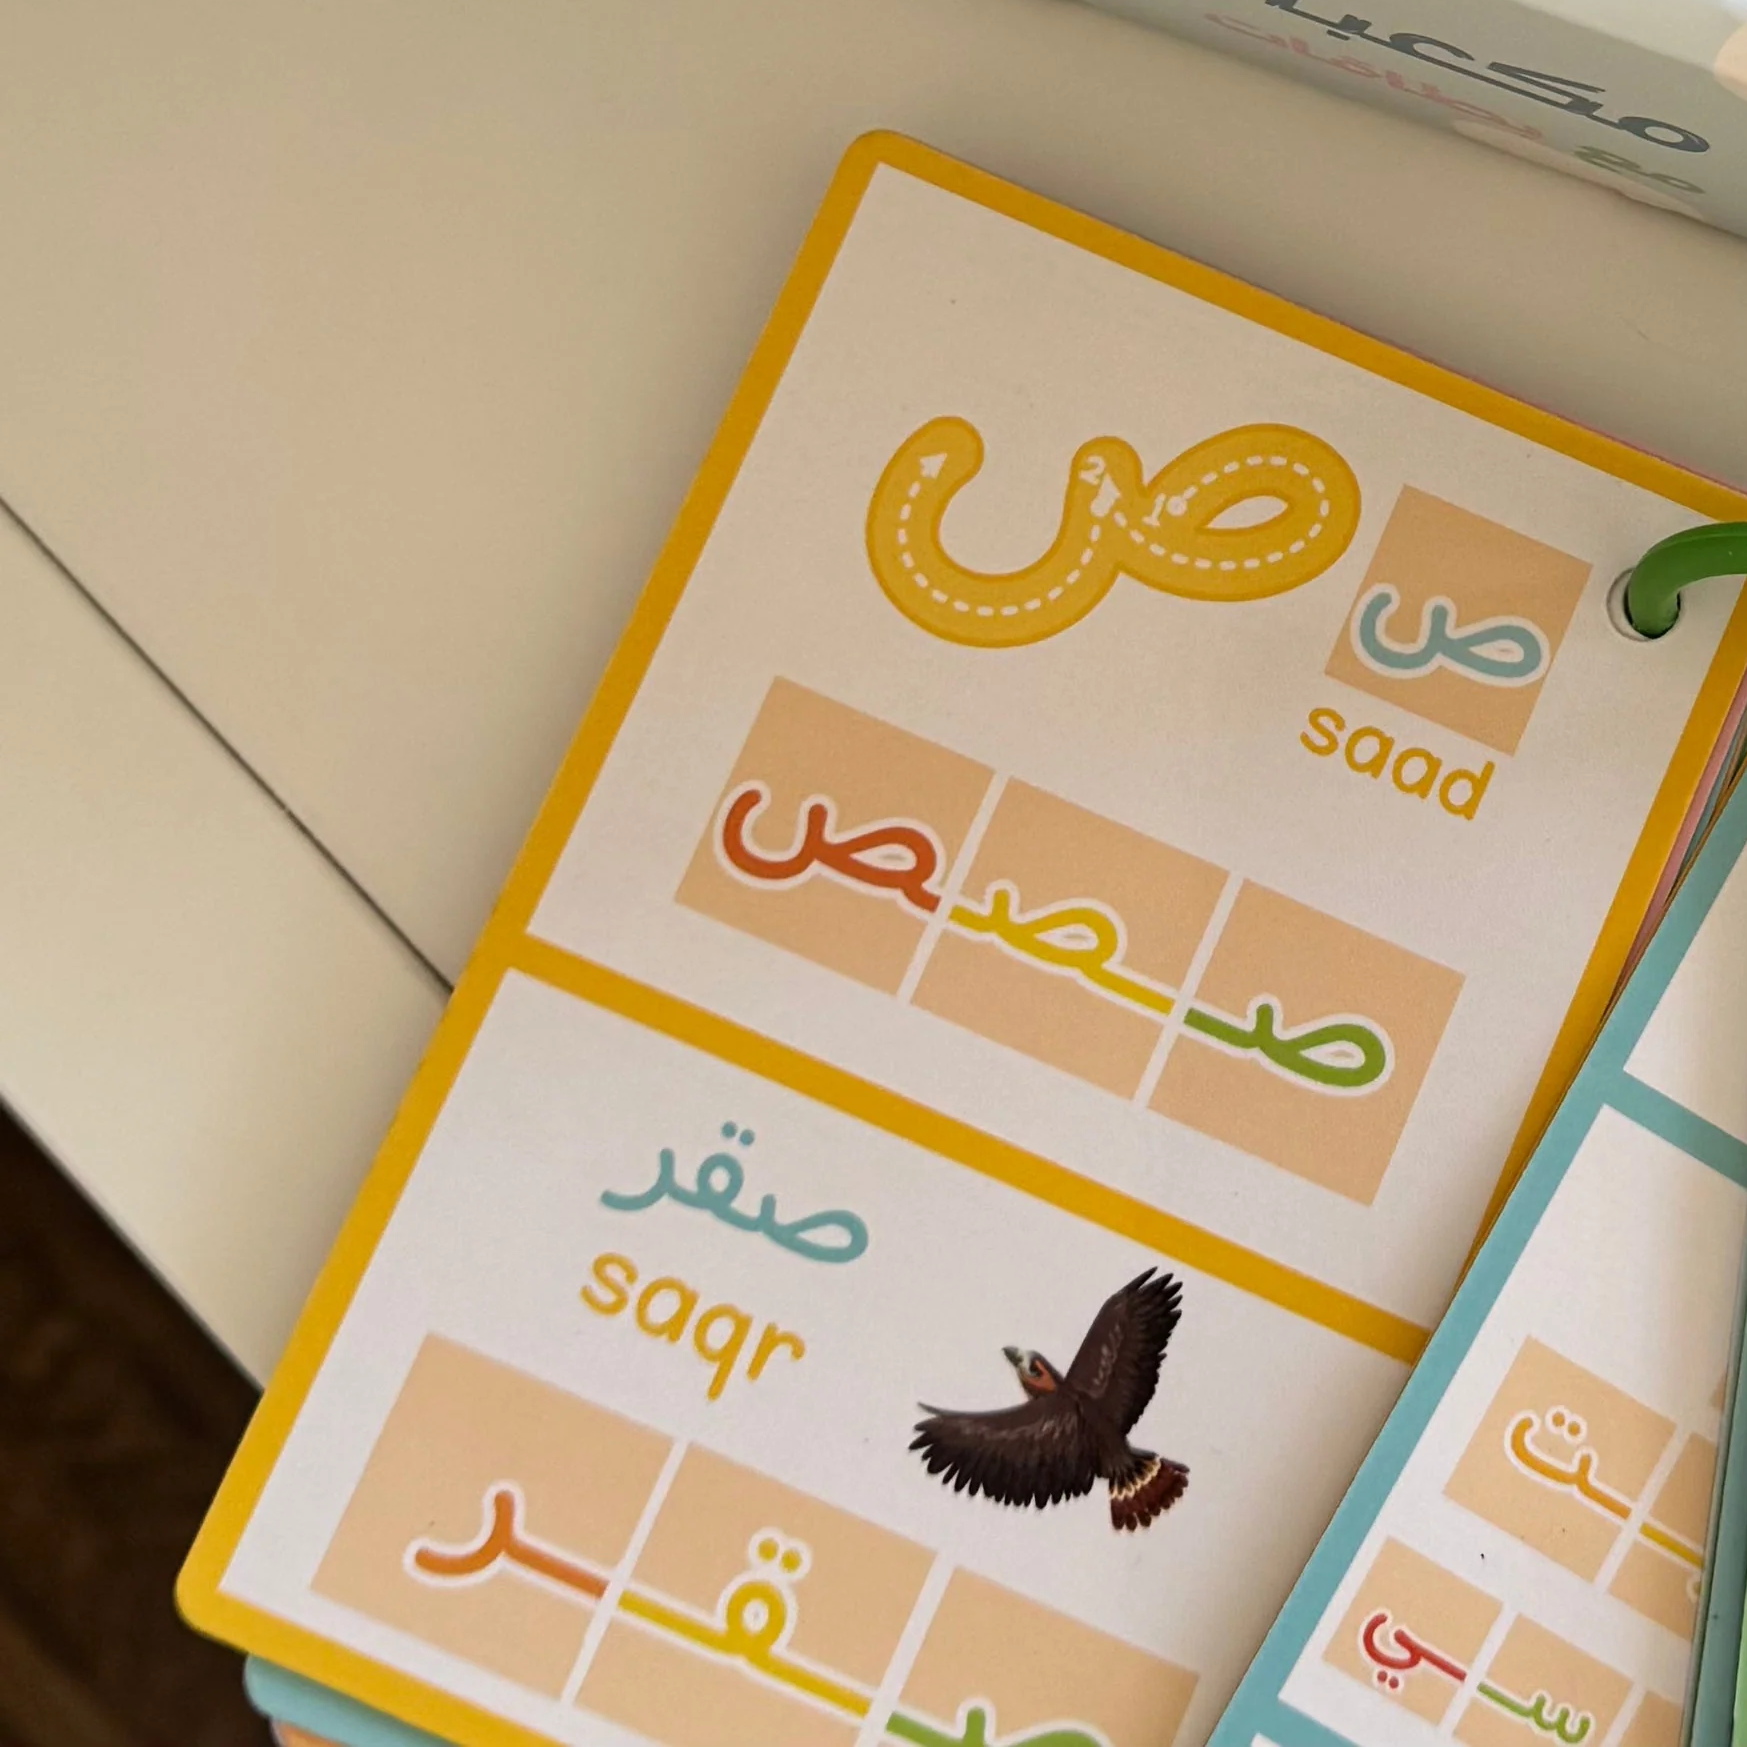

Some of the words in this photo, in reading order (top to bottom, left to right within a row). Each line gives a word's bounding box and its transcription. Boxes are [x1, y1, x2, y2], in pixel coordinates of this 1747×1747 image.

[1353, 582, 1548, 687] ص
[1298, 704, 1497, 822] saad
[599, 1122, 869, 1264] صقر
[579, 1251, 807, 1402] saqr
